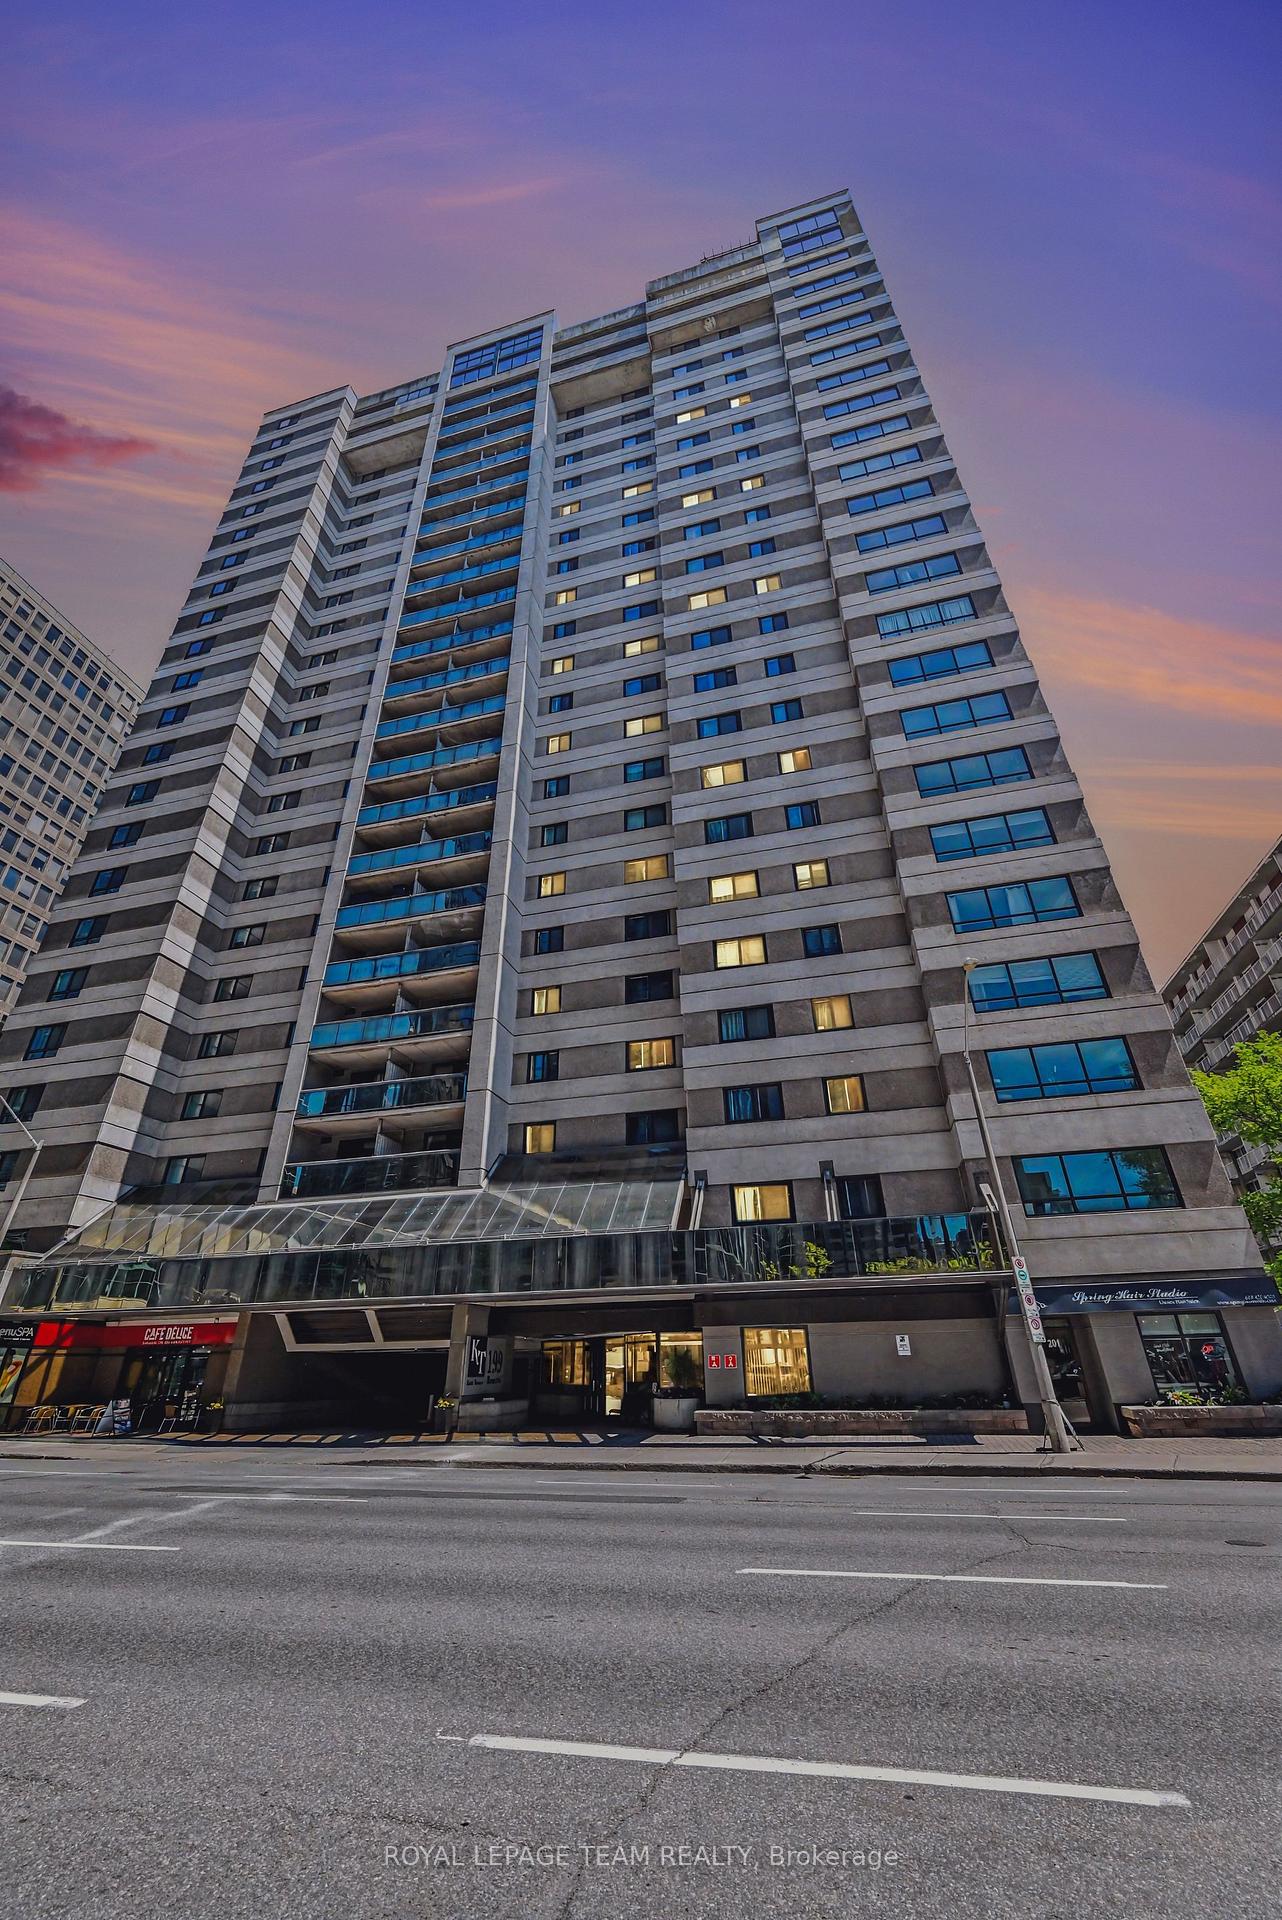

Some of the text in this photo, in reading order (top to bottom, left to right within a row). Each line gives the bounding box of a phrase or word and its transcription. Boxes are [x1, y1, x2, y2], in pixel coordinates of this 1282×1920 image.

[1072, 1288, 1188, 1305] Spring Hair Studio
